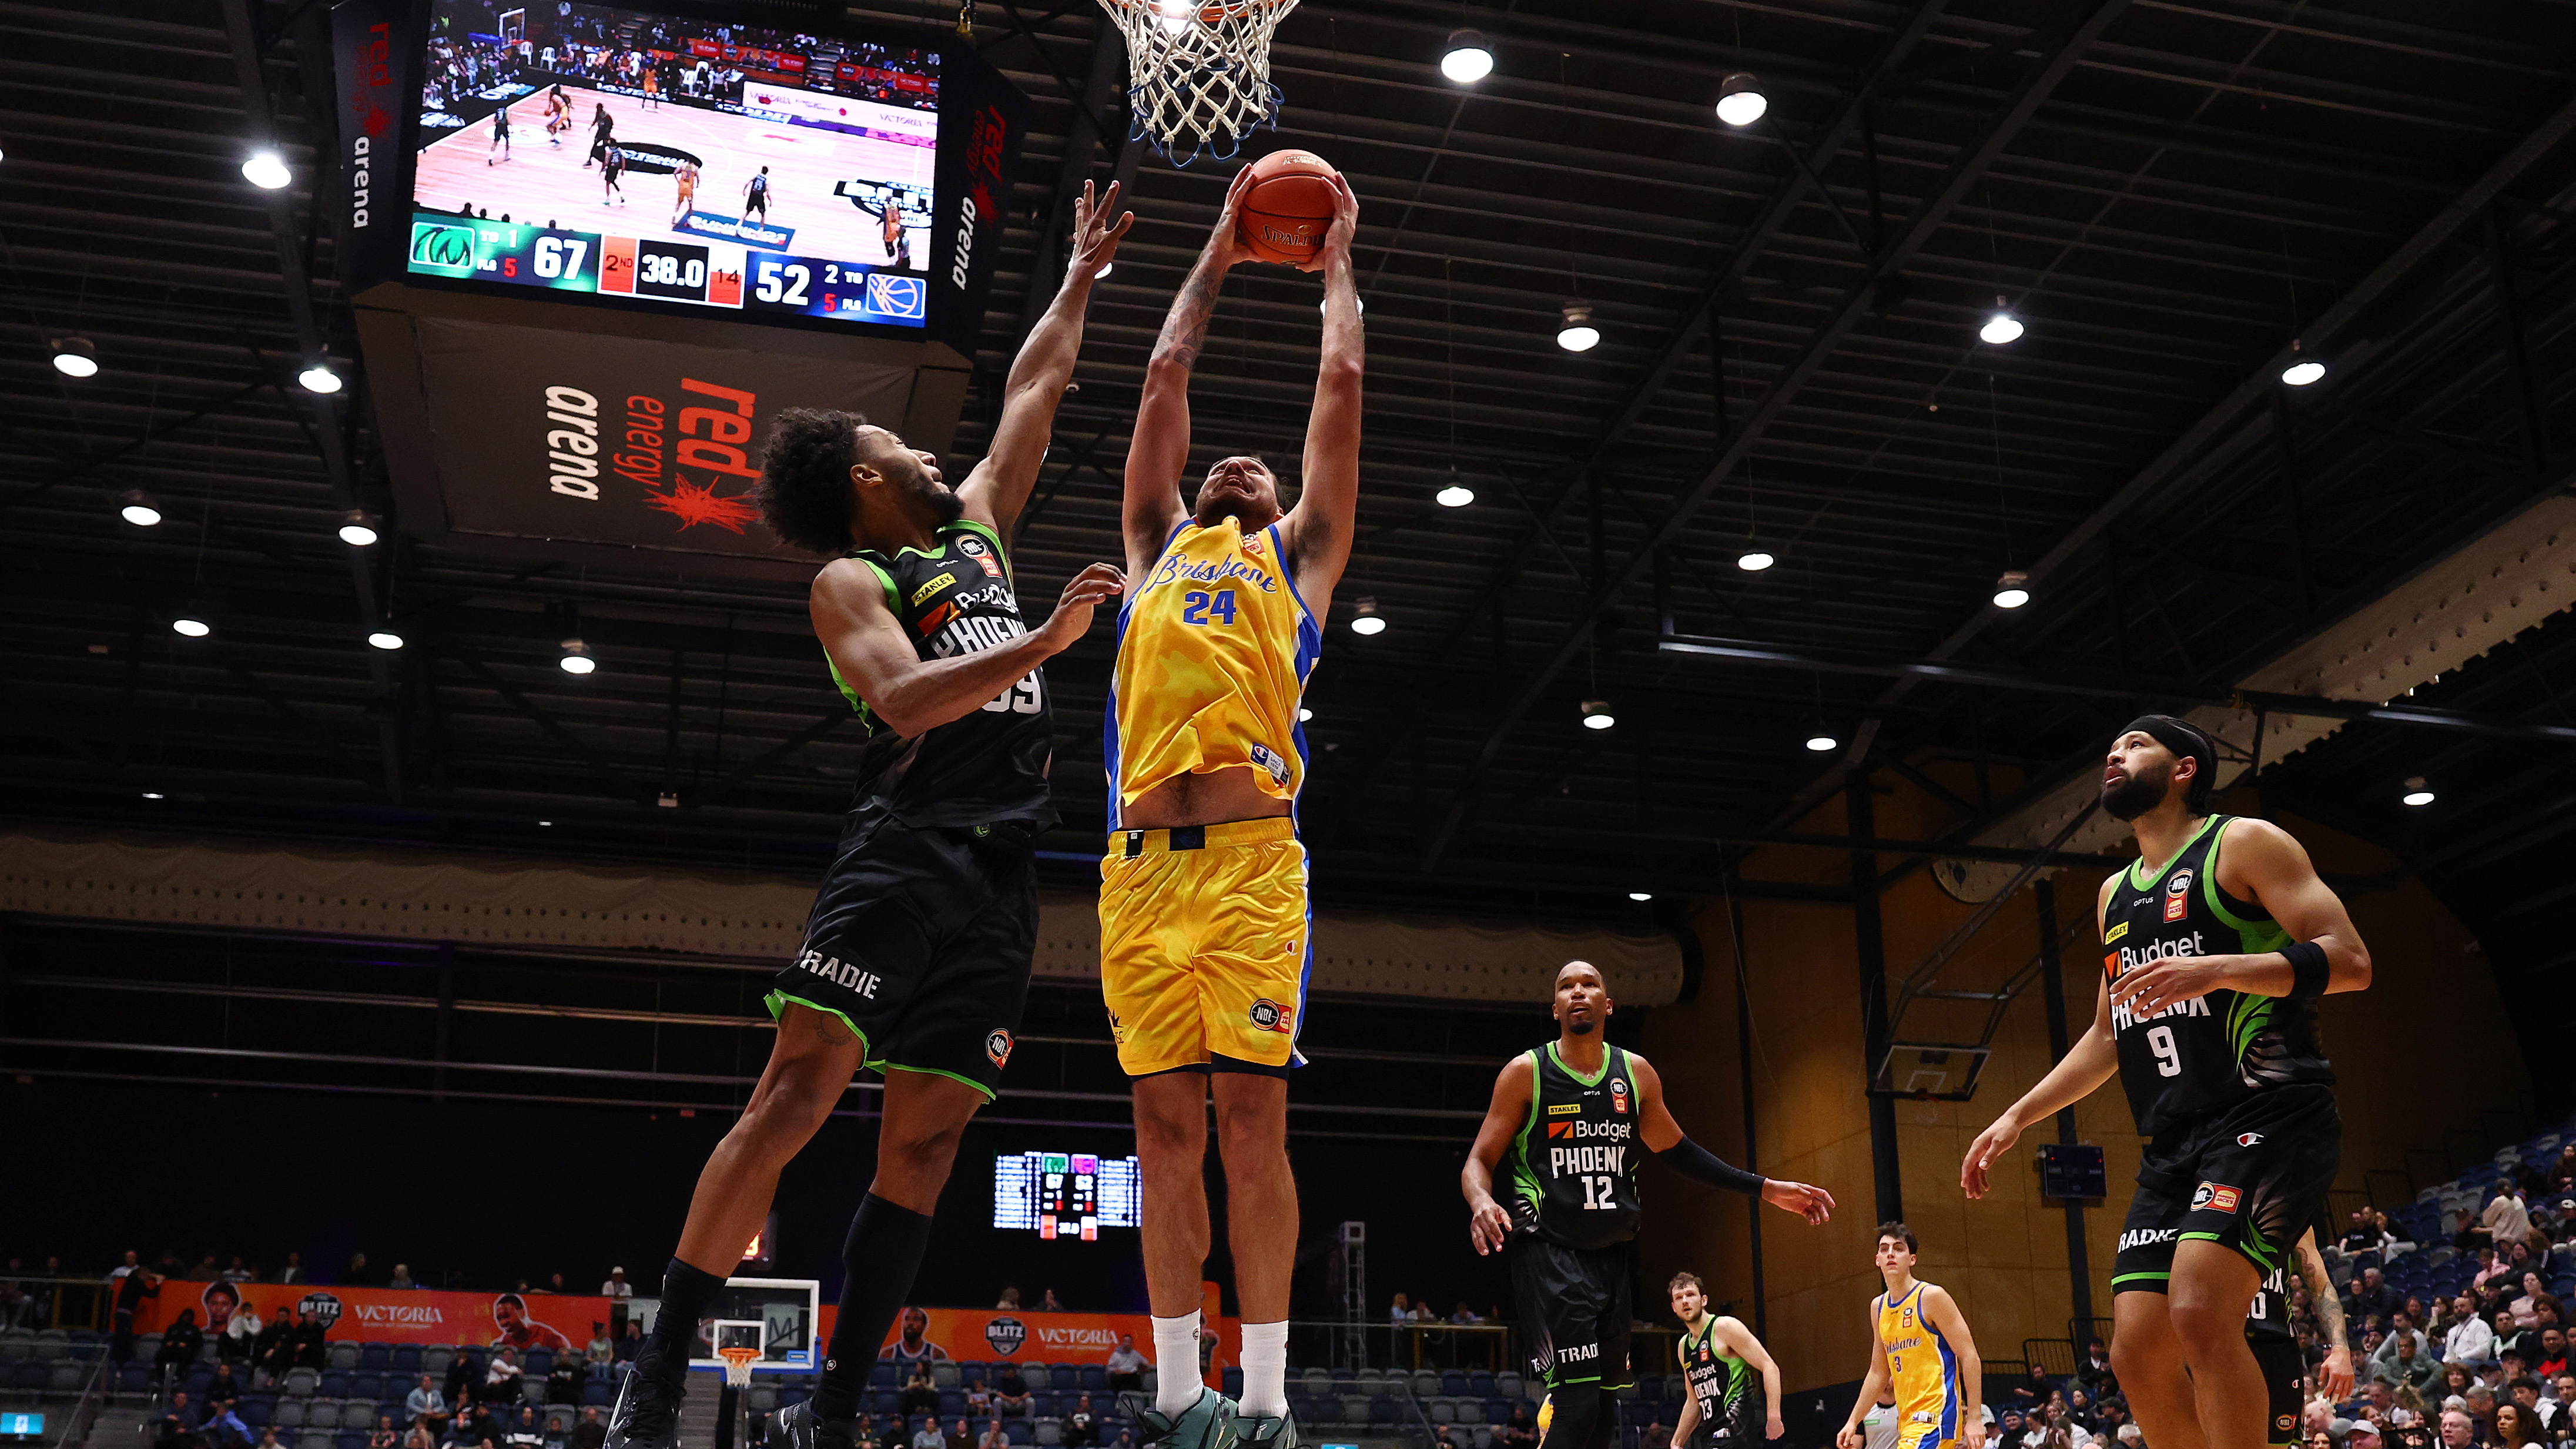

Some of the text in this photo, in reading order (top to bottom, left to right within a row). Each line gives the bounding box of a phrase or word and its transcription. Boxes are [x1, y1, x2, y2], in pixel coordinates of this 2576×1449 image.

[370, 22, 393, 87] red
[983, 105, 1006, 183] red
[353, 136, 370, 229] arena
[479, 229, 518, 248] TO 1
[952, 196, 976, 290] arena
[1262, 223, 1326, 247] SPALDI
[503, 257, 518, 278] 5
[533, 236, 588, 280] 67
[605, 255, 633, 271] 2ND
[640, 254, 705, 288] 38.0
[716, 268, 739, 285] 14
[824, 265, 863, 284] 2 TO
[755, 261, 810, 306] 52
[823, 293, 837, 313] 5
[676, 377, 763, 478] red
[545, 384, 599, 501] arena
[612, 395, 665, 487] energy
[962, 541, 983, 554] NBL
[1145, 553, 1277, 594] Brisbane
[1183, 590, 1237, 627] 24
[981, 668, 1041, 714] 9
[2172, 876, 2189, 891] NBL
[2133, 896, 2154, 906] OPTUS
[2121, 931, 2205, 973] Budget
[1255, 1006, 1272, 1022] NBL
[992, 1036, 1006, 1055] NBL
[2146, 1025, 2182, 1077] 9
[1613, 1083, 1624, 1093] NBL
[1576, 1119, 1632, 1142] Budget
[1582, 1176, 1617, 1210] 12
[355, 1304, 443, 1323] VICTORIA
[2246, 1291, 2266, 1320] 0
[987, 1325, 1024, 1338] BLITZ
[1037, 1328, 1119, 1344] VICTORIA
[1894, 1356, 1902, 1373] 3
[1694, 1377, 1721, 1400] OENIX
[1699, 1398, 1713, 1421] 13
